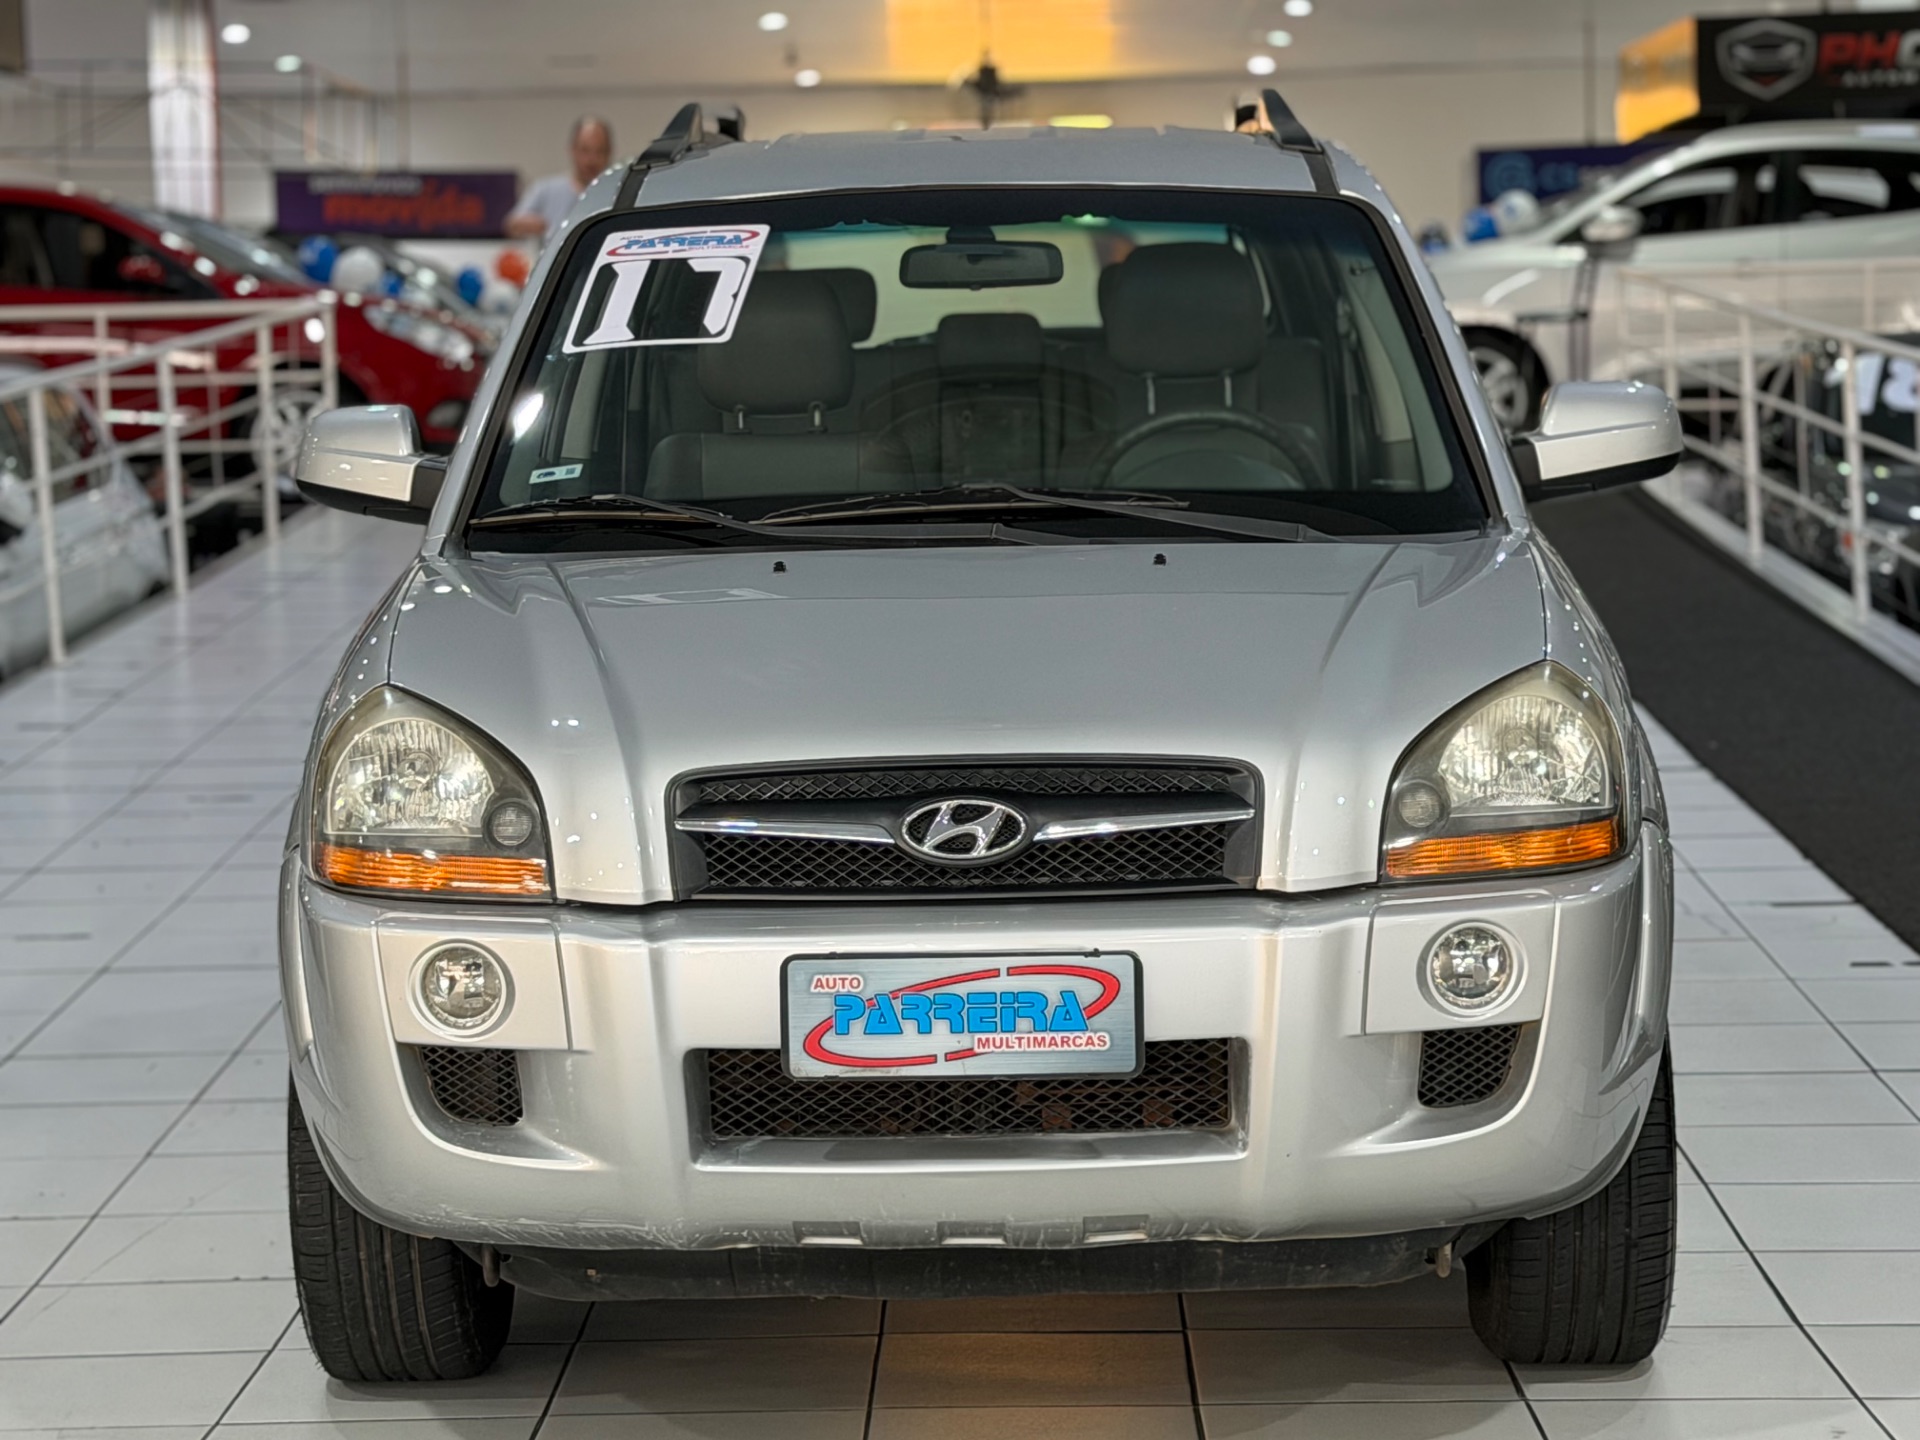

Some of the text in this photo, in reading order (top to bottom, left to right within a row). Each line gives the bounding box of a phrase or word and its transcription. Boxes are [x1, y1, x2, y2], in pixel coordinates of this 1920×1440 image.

[614, 234, 743, 250] PARREIRA
[583, 257, 747, 345] 17
[813, 976, 861, 991] AUTO
[833, 990, 1090, 1036] PARREIRA
[976, 1033, 1108, 1050] MULTIMARCAS
